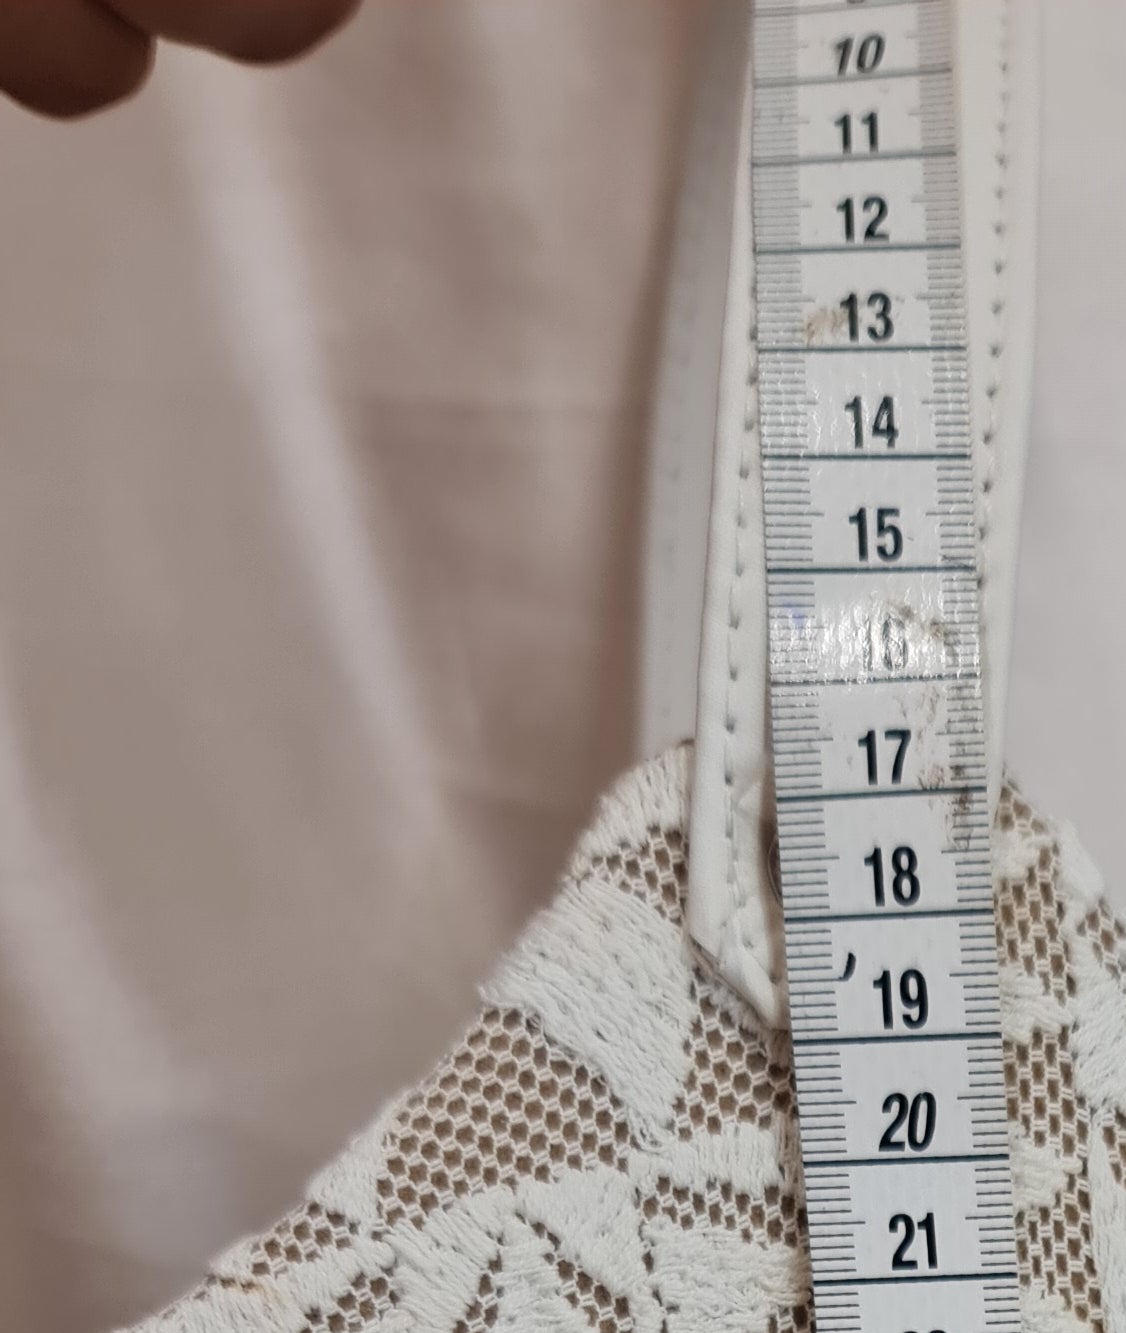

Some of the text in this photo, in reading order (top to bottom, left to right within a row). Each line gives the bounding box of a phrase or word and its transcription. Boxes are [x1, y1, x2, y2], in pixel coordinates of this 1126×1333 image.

[836, 34, 884, 76] 10
[835, 112, 878, 153] 11
[837, 197, 888, 241] 12
[840, 292, 893, 341] 13
[845, 396, 898, 448] 14
[849, 508, 902, 561] 15
[858, 729, 911, 784] 17
[865, 846, 920, 906] 18
[873, 969, 928, 1028] 19
[879, 1092, 936, 1151] 20
[889, 1213, 937, 1270] 21
